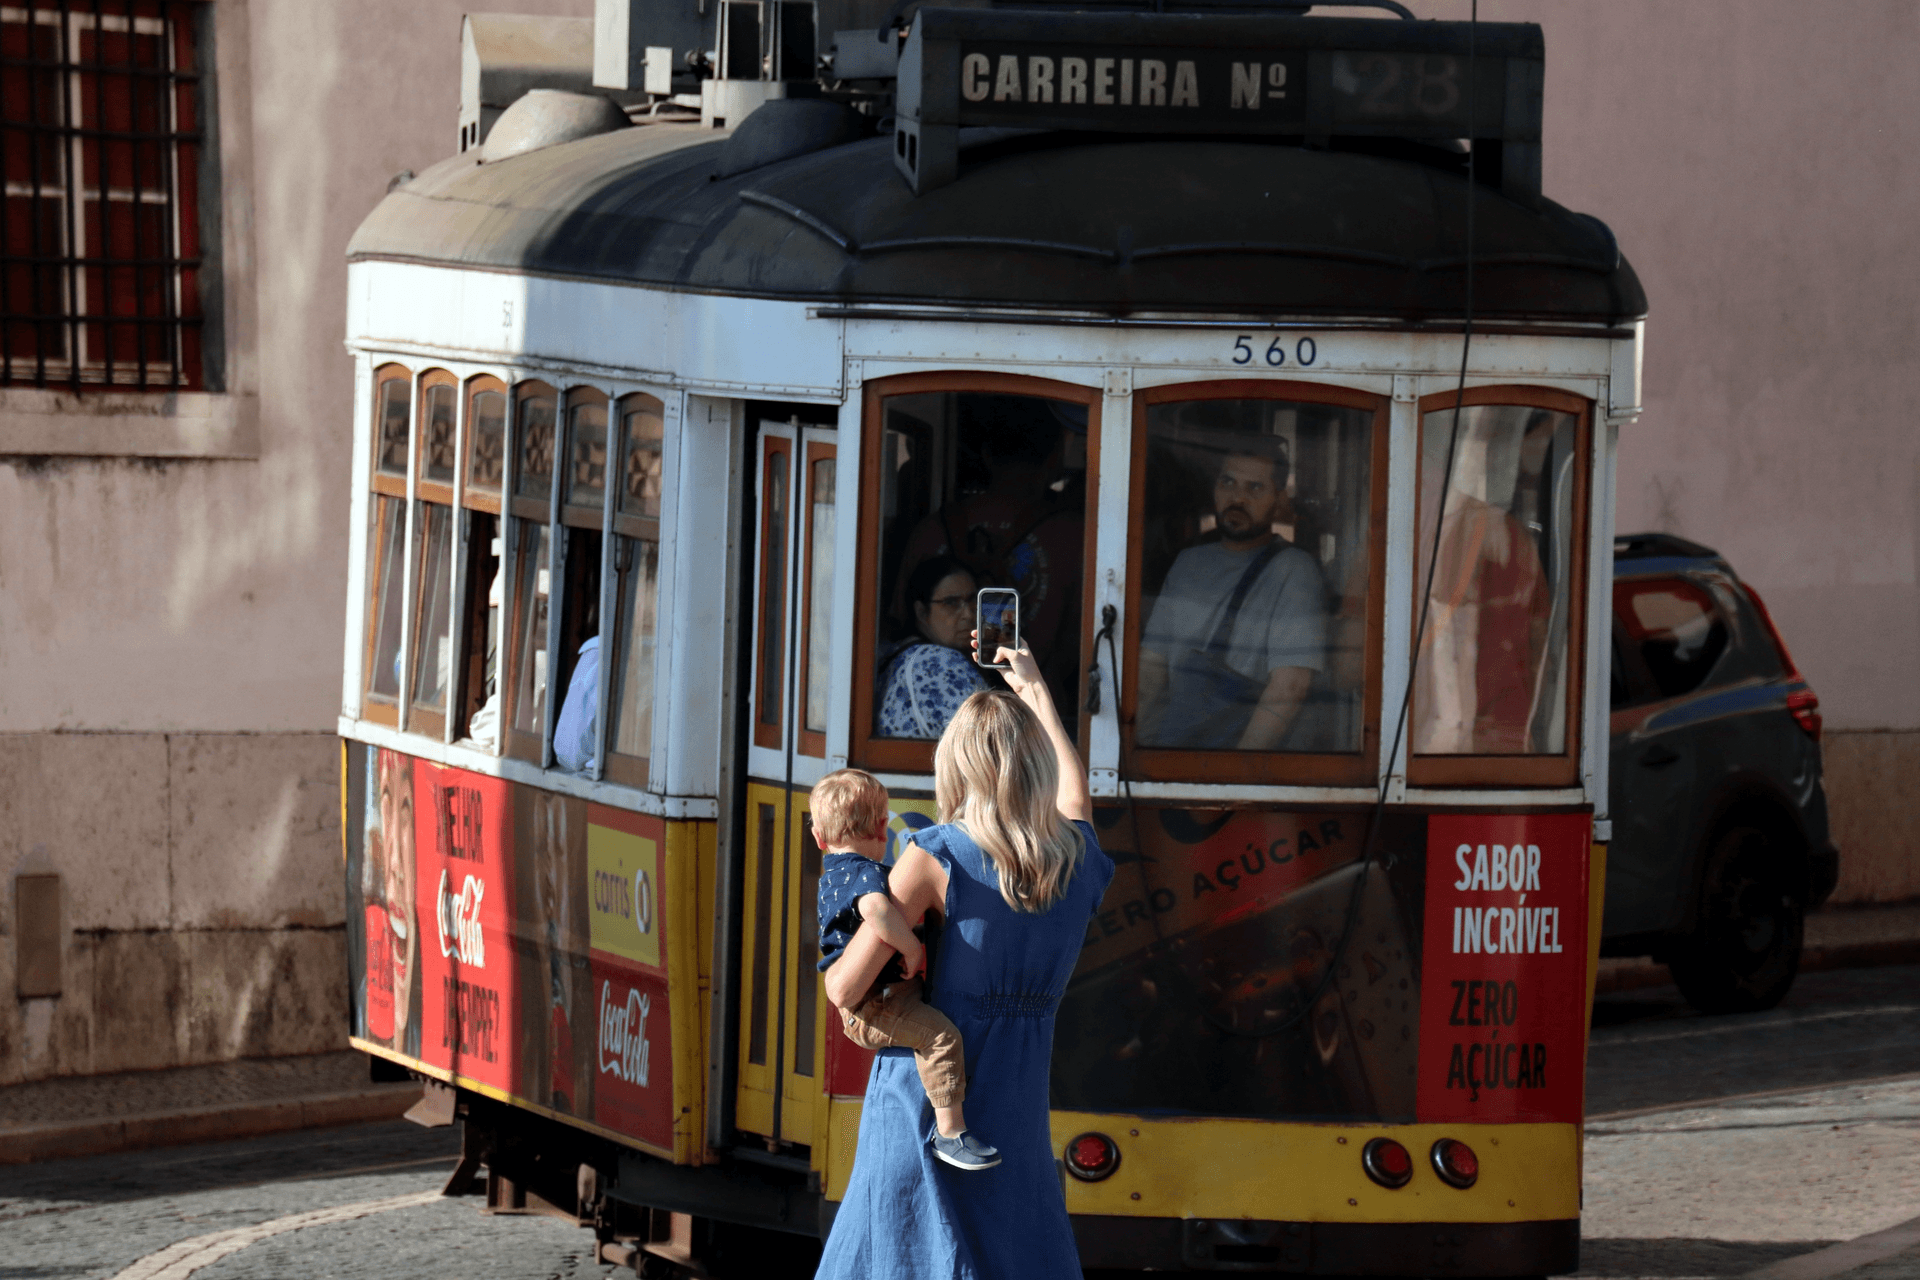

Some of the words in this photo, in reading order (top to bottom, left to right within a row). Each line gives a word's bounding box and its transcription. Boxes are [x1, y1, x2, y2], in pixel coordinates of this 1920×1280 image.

[962, 51, 1200, 109] CARREIRA
[1233, 333, 1317, 367] 560
[594, 858, 631, 919] carris
[1191, 819, 1346, 899] AÇÚCAR
[1455, 843, 1542, 892] SABOR
[1452, 895, 1563, 955] INCRÍVEL
[599, 978, 651, 1088] Coca-Cola
[1449, 979, 1518, 1027] ZERO
[1447, 1029, 1547, 1102] AÇÚCAR
